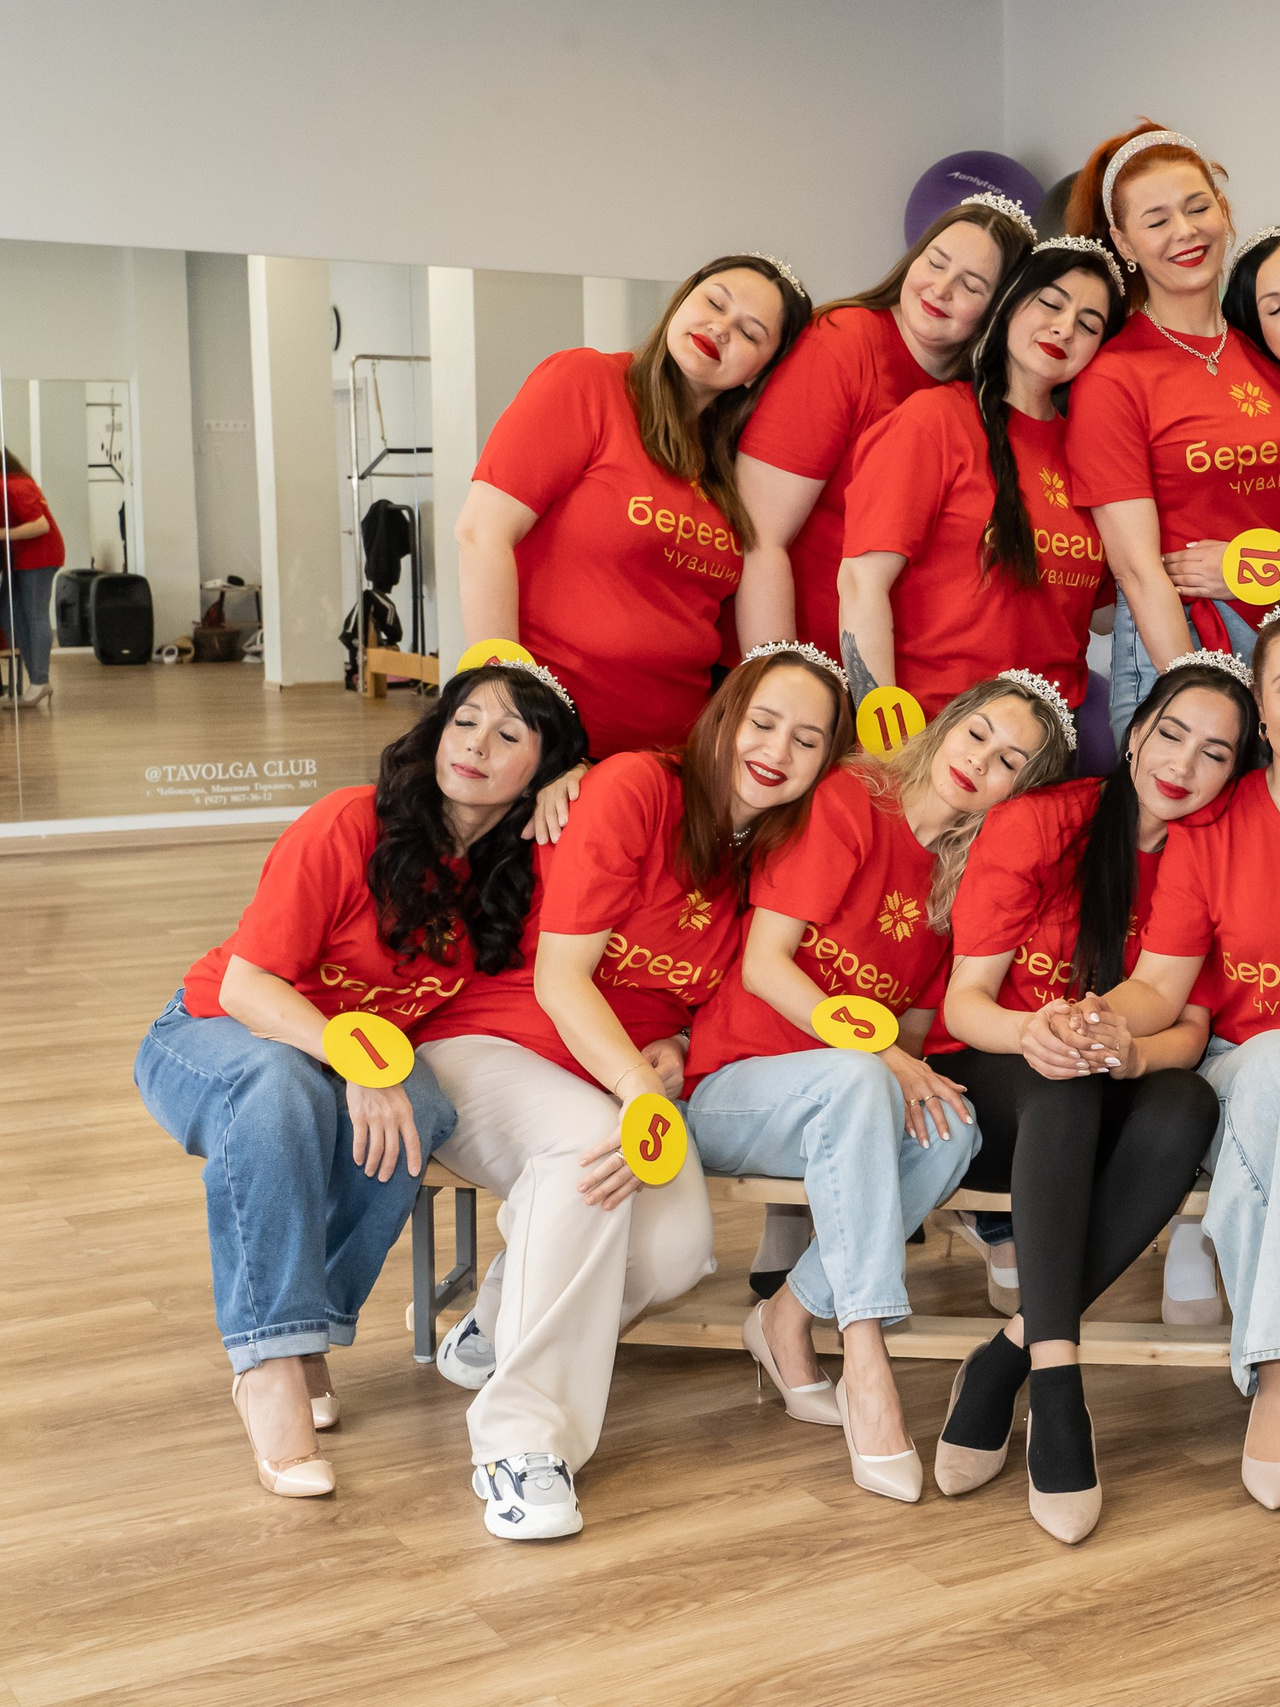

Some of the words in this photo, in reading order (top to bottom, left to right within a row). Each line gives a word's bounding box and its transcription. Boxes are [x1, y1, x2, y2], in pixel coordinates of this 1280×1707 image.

[874, 702, 910, 751] 11
[145, 763, 258, 782] @TAVOLGA
[263, 758, 317, 777] CLUB
[350, 1027, 389, 1070] 1
